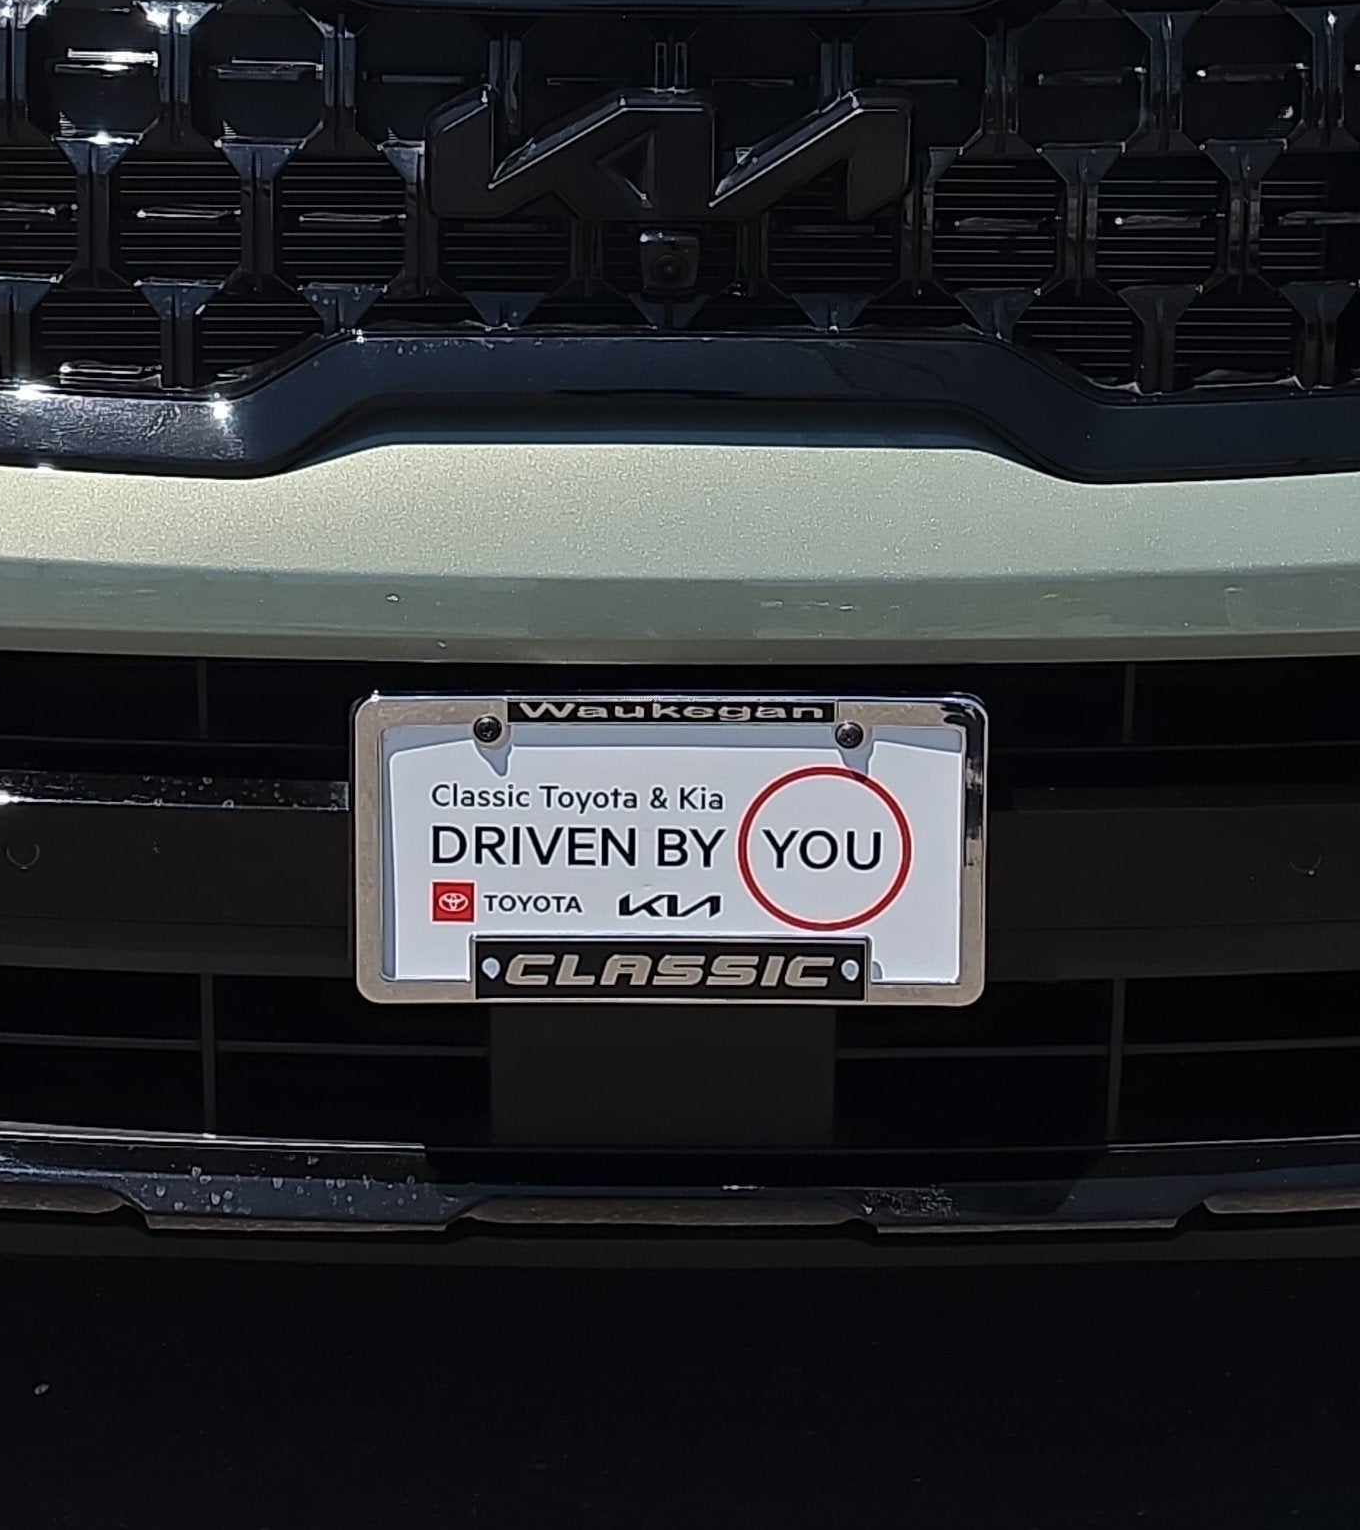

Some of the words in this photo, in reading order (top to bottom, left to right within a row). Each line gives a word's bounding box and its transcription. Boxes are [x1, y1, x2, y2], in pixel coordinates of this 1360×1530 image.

[519, 702, 824, 721] Waukegan
[431, 783, 530, 808] Classic
[539, 785, 638, 814] Toyota
[649, 786, 669, 810] &
[679, 787, 724, 810] Kia
[431, 825, 637, 867] DRIVEN
[656, 828, 726, 868] BY
[762, 829, 883, 871] YOU
[483, 894, 584, 914] TOYOTA
[504, 953, 835, 987] CLASSIC
